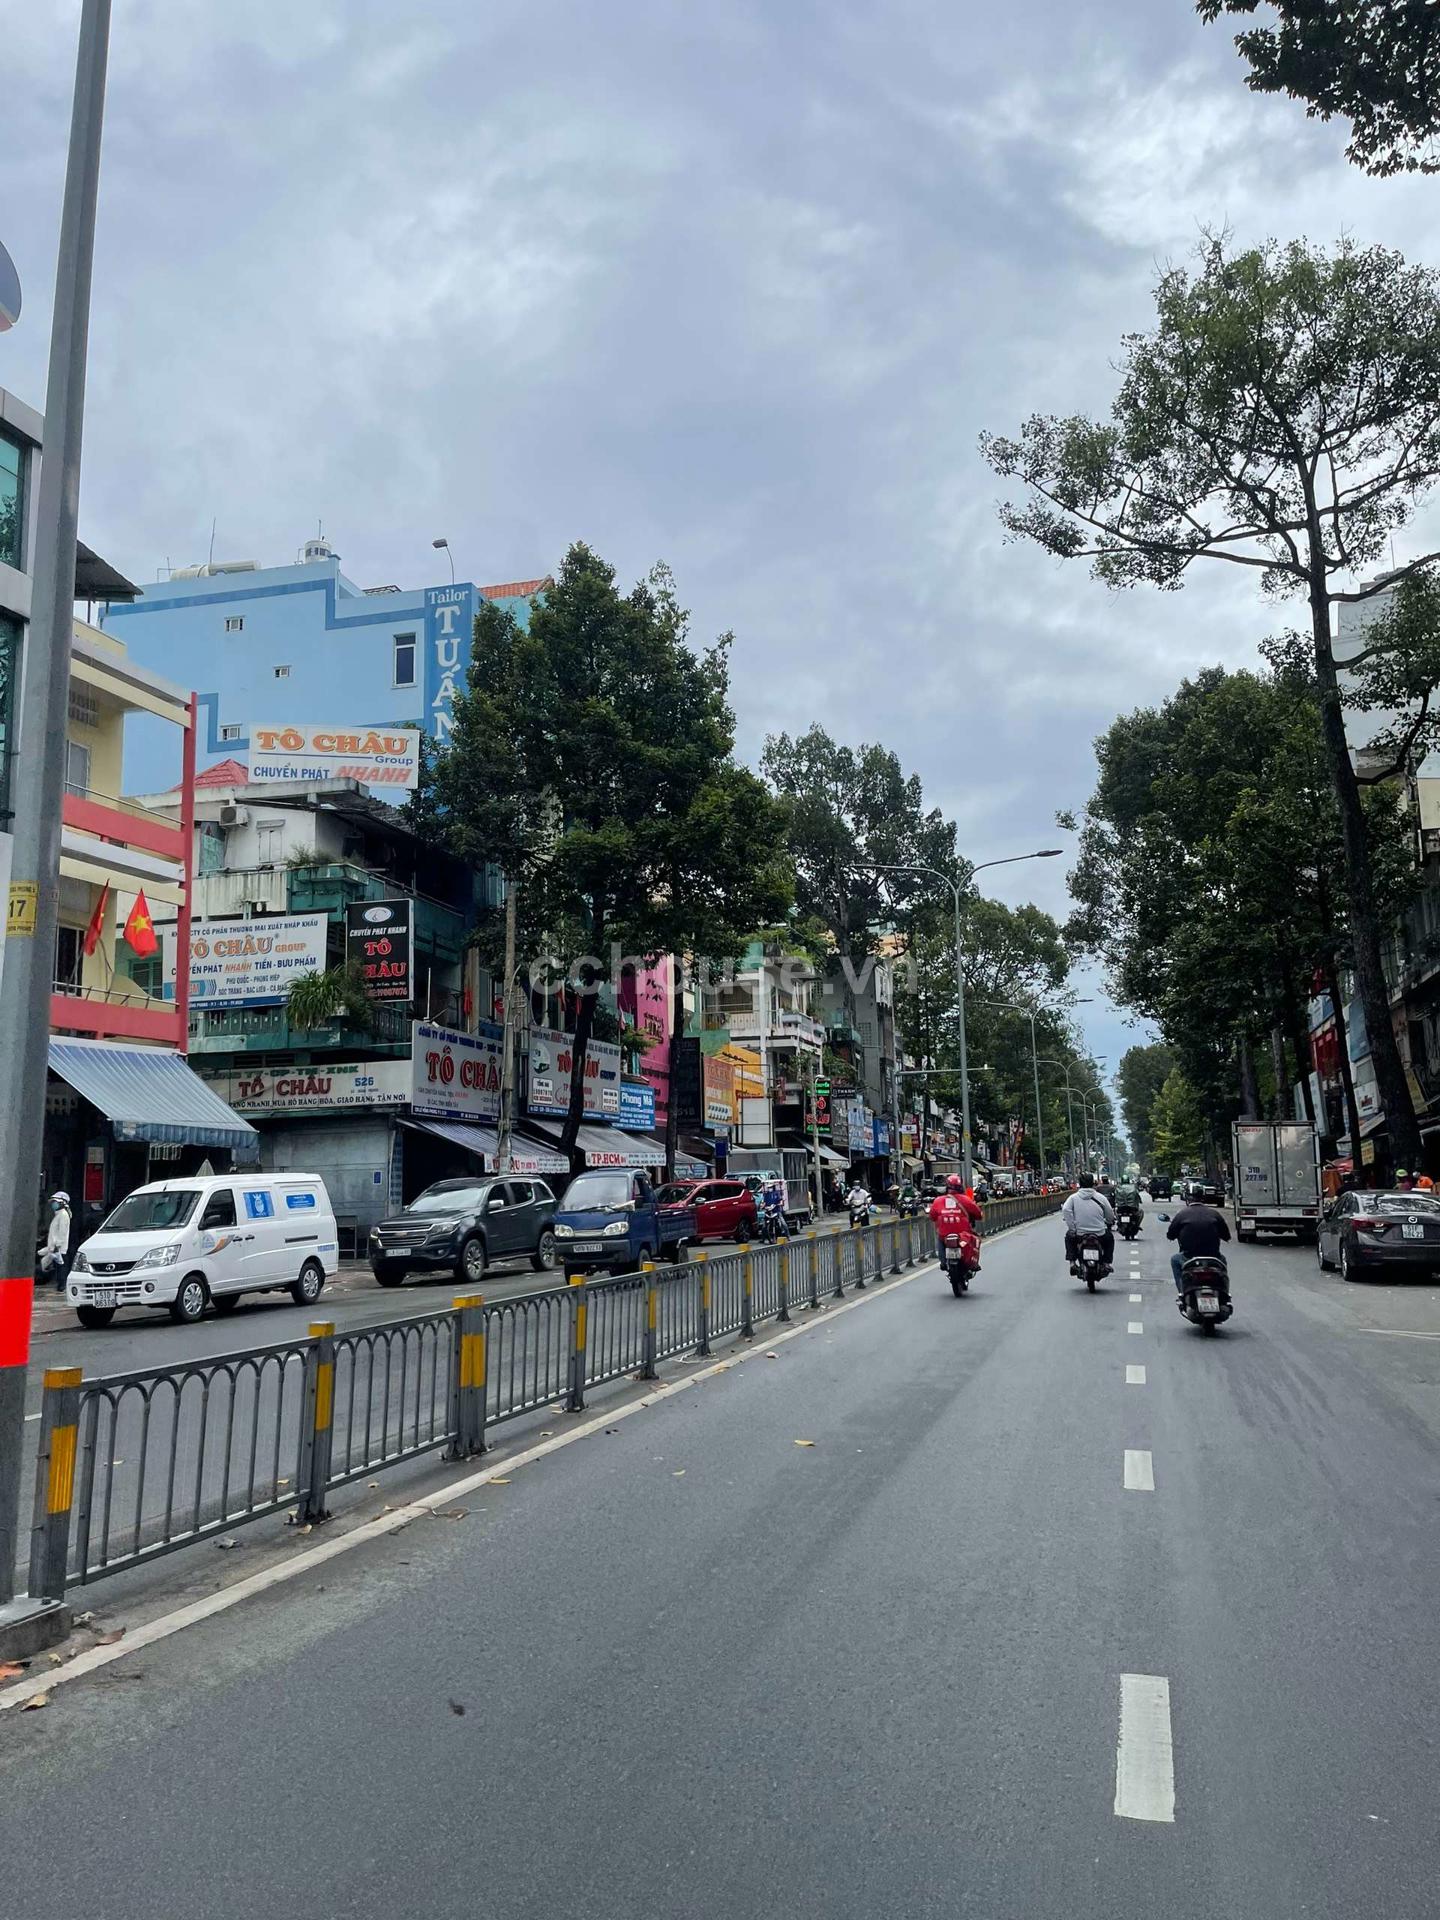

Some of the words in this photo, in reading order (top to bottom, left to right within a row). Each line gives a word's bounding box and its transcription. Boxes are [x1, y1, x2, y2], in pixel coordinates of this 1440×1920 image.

[428, 589, 469, 604] Tailor
[256, 728, 305, 751] TÔ
[312, 731, 409, 755] CHÂU
[375, 756, 414, 766] Group
[254, 762, 298, 778] CHUYỂN
[335, 765, 412, 783] NHANH
[213, 934, 274, 957] CHÂU
[275, 942, 307, 954] GROUP
[364, 937, 392, 956] TÔ
[426, 1044, 454, 1085] TÔ
[461, 1055, 503, 1092] CHÂ
[557, 1050, 573, 1074] TÔ
[239, 1076, 264, 1098] TÔ
[276, 1074, 332, 1095] CHÂU
[355, 1077, 374, 1087] 526
[621, 1090, 641, 1107] Phong
[591, 1153, 621, 1166] TP.HCM
